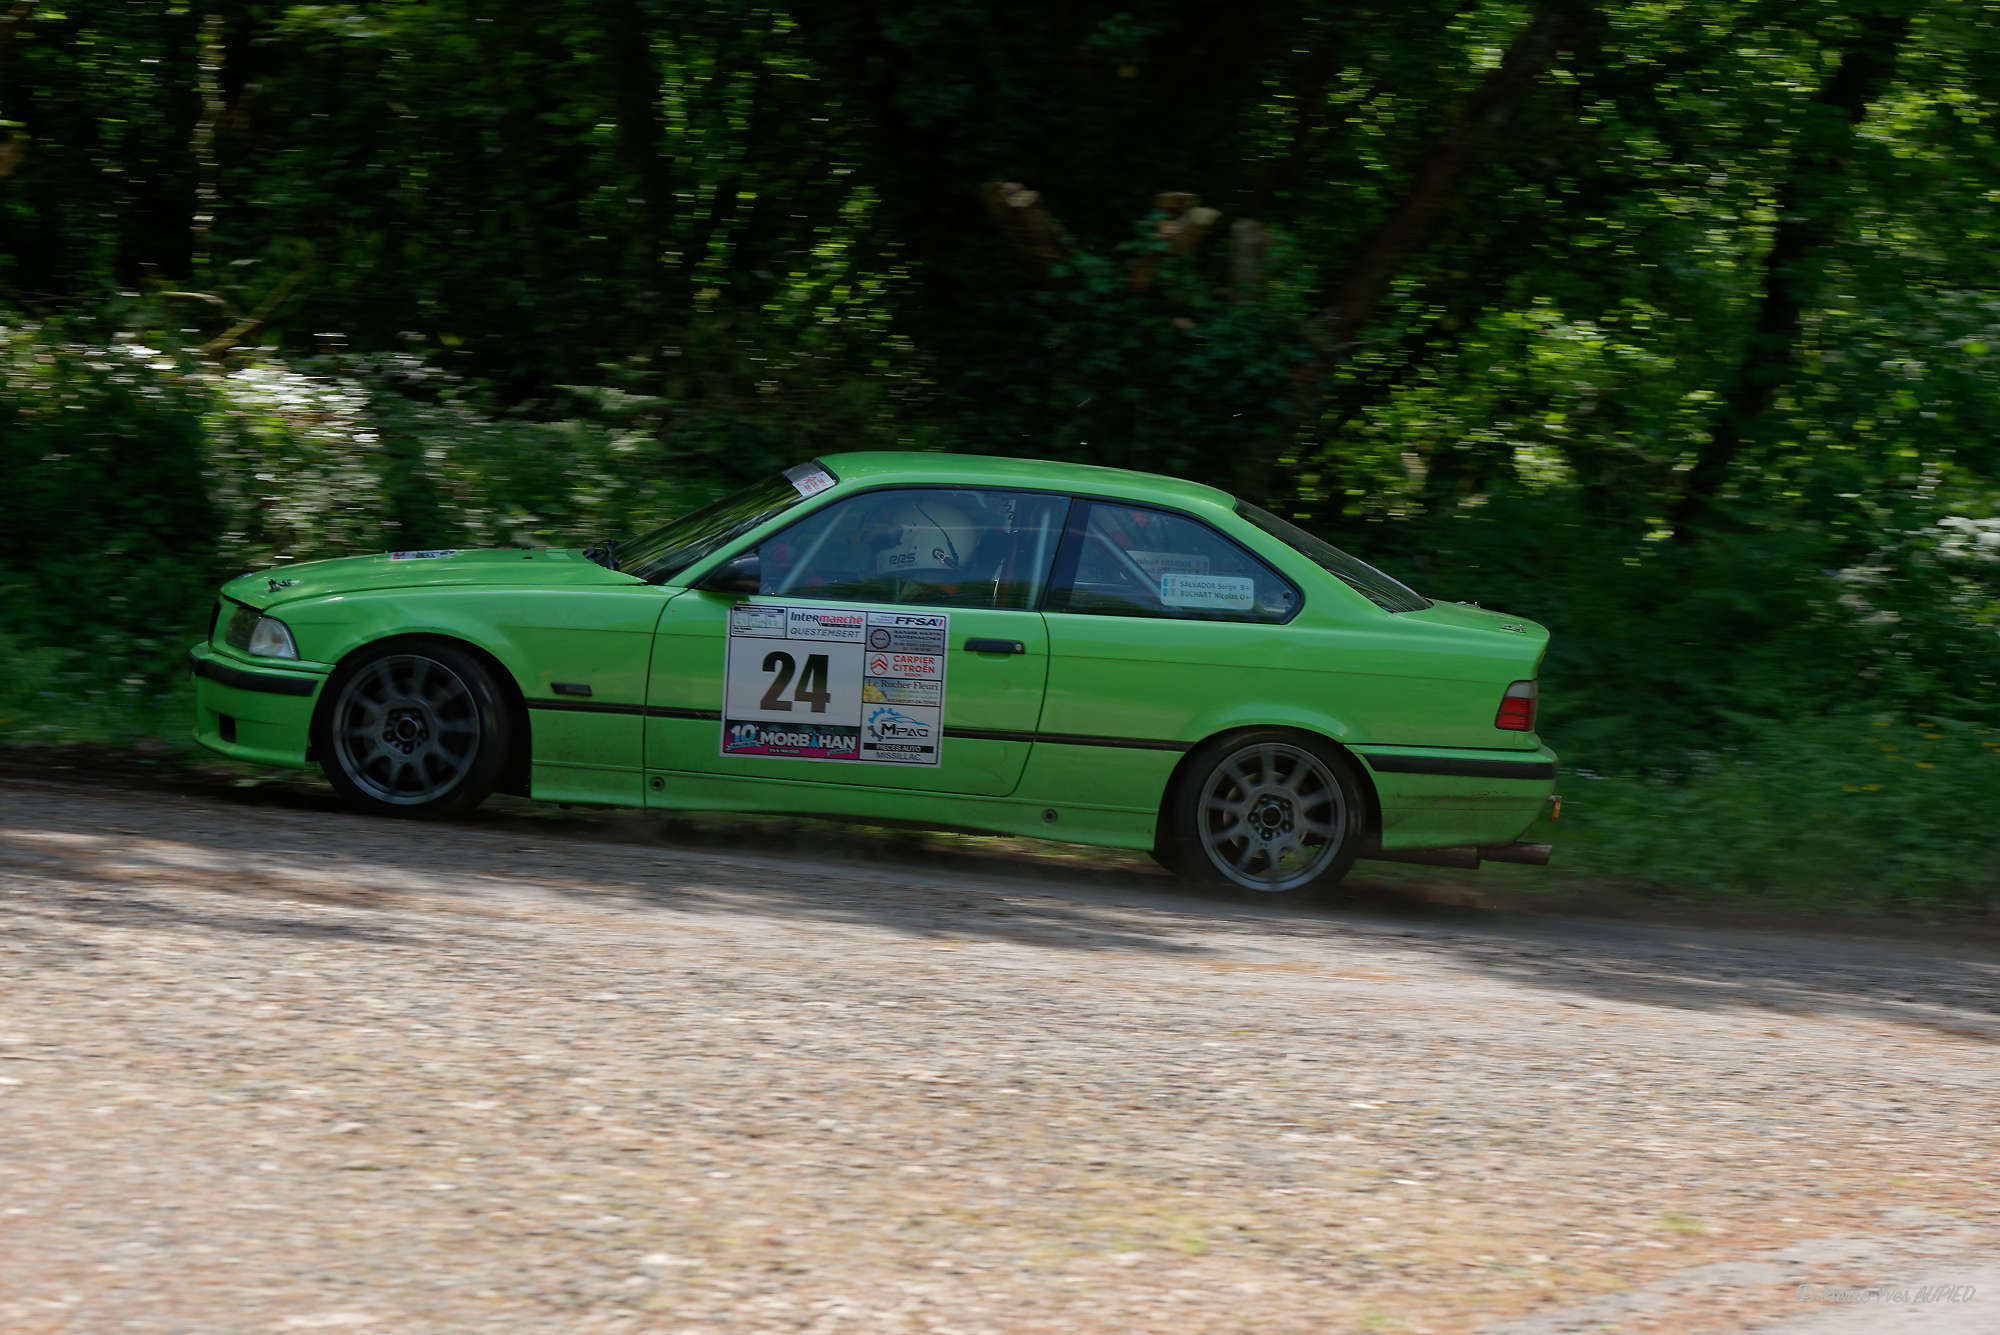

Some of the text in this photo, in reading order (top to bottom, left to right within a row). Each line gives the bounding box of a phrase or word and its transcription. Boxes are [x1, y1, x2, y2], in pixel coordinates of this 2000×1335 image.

[1179, 581, 1216, 590] SALVADOR
[790, 611, 863, 627] Intermarché
[895, 616, 937, 627] FFSA
[790, 627, 860, 638] QUESTEMBERT
[893, 655, 935, 665] CARPIER
[760, 651, 831, 713] 24
[876, 751, 921, 761] MISSILLAC
